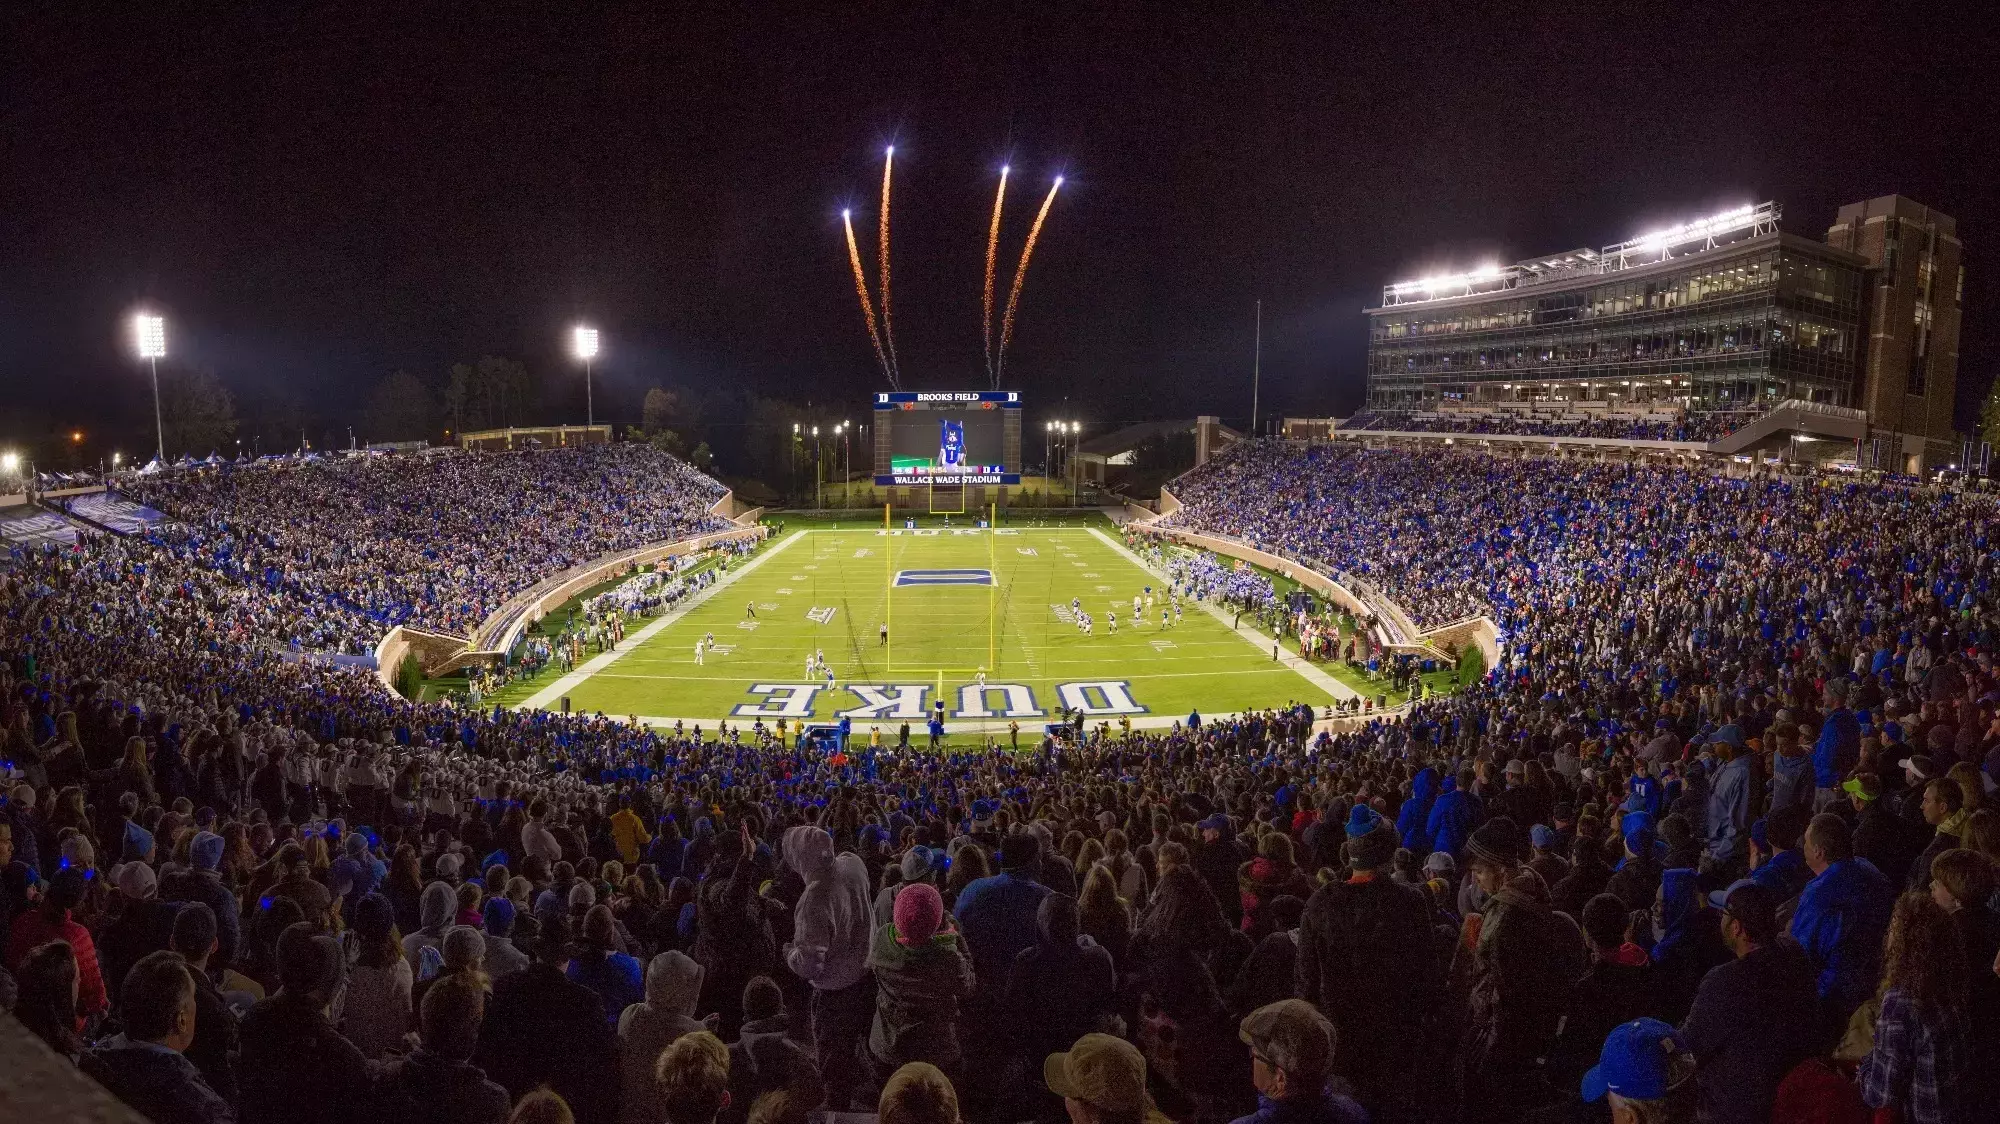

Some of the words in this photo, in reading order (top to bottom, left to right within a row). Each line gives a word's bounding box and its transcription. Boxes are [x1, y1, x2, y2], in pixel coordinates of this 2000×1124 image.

[879, 394, 889, 402] D
[917, 393, 953, 401] BROOKS
[954, 393, 980, 401] FIELD
[1008, 392, 1017, 401] D
[894, 476, 933, 484] WALLACE
[935, 476, 960, 484] WADE
[961, 475, 1001, 484] STADIUM
[729, 680, 1152, 718] DUKE
